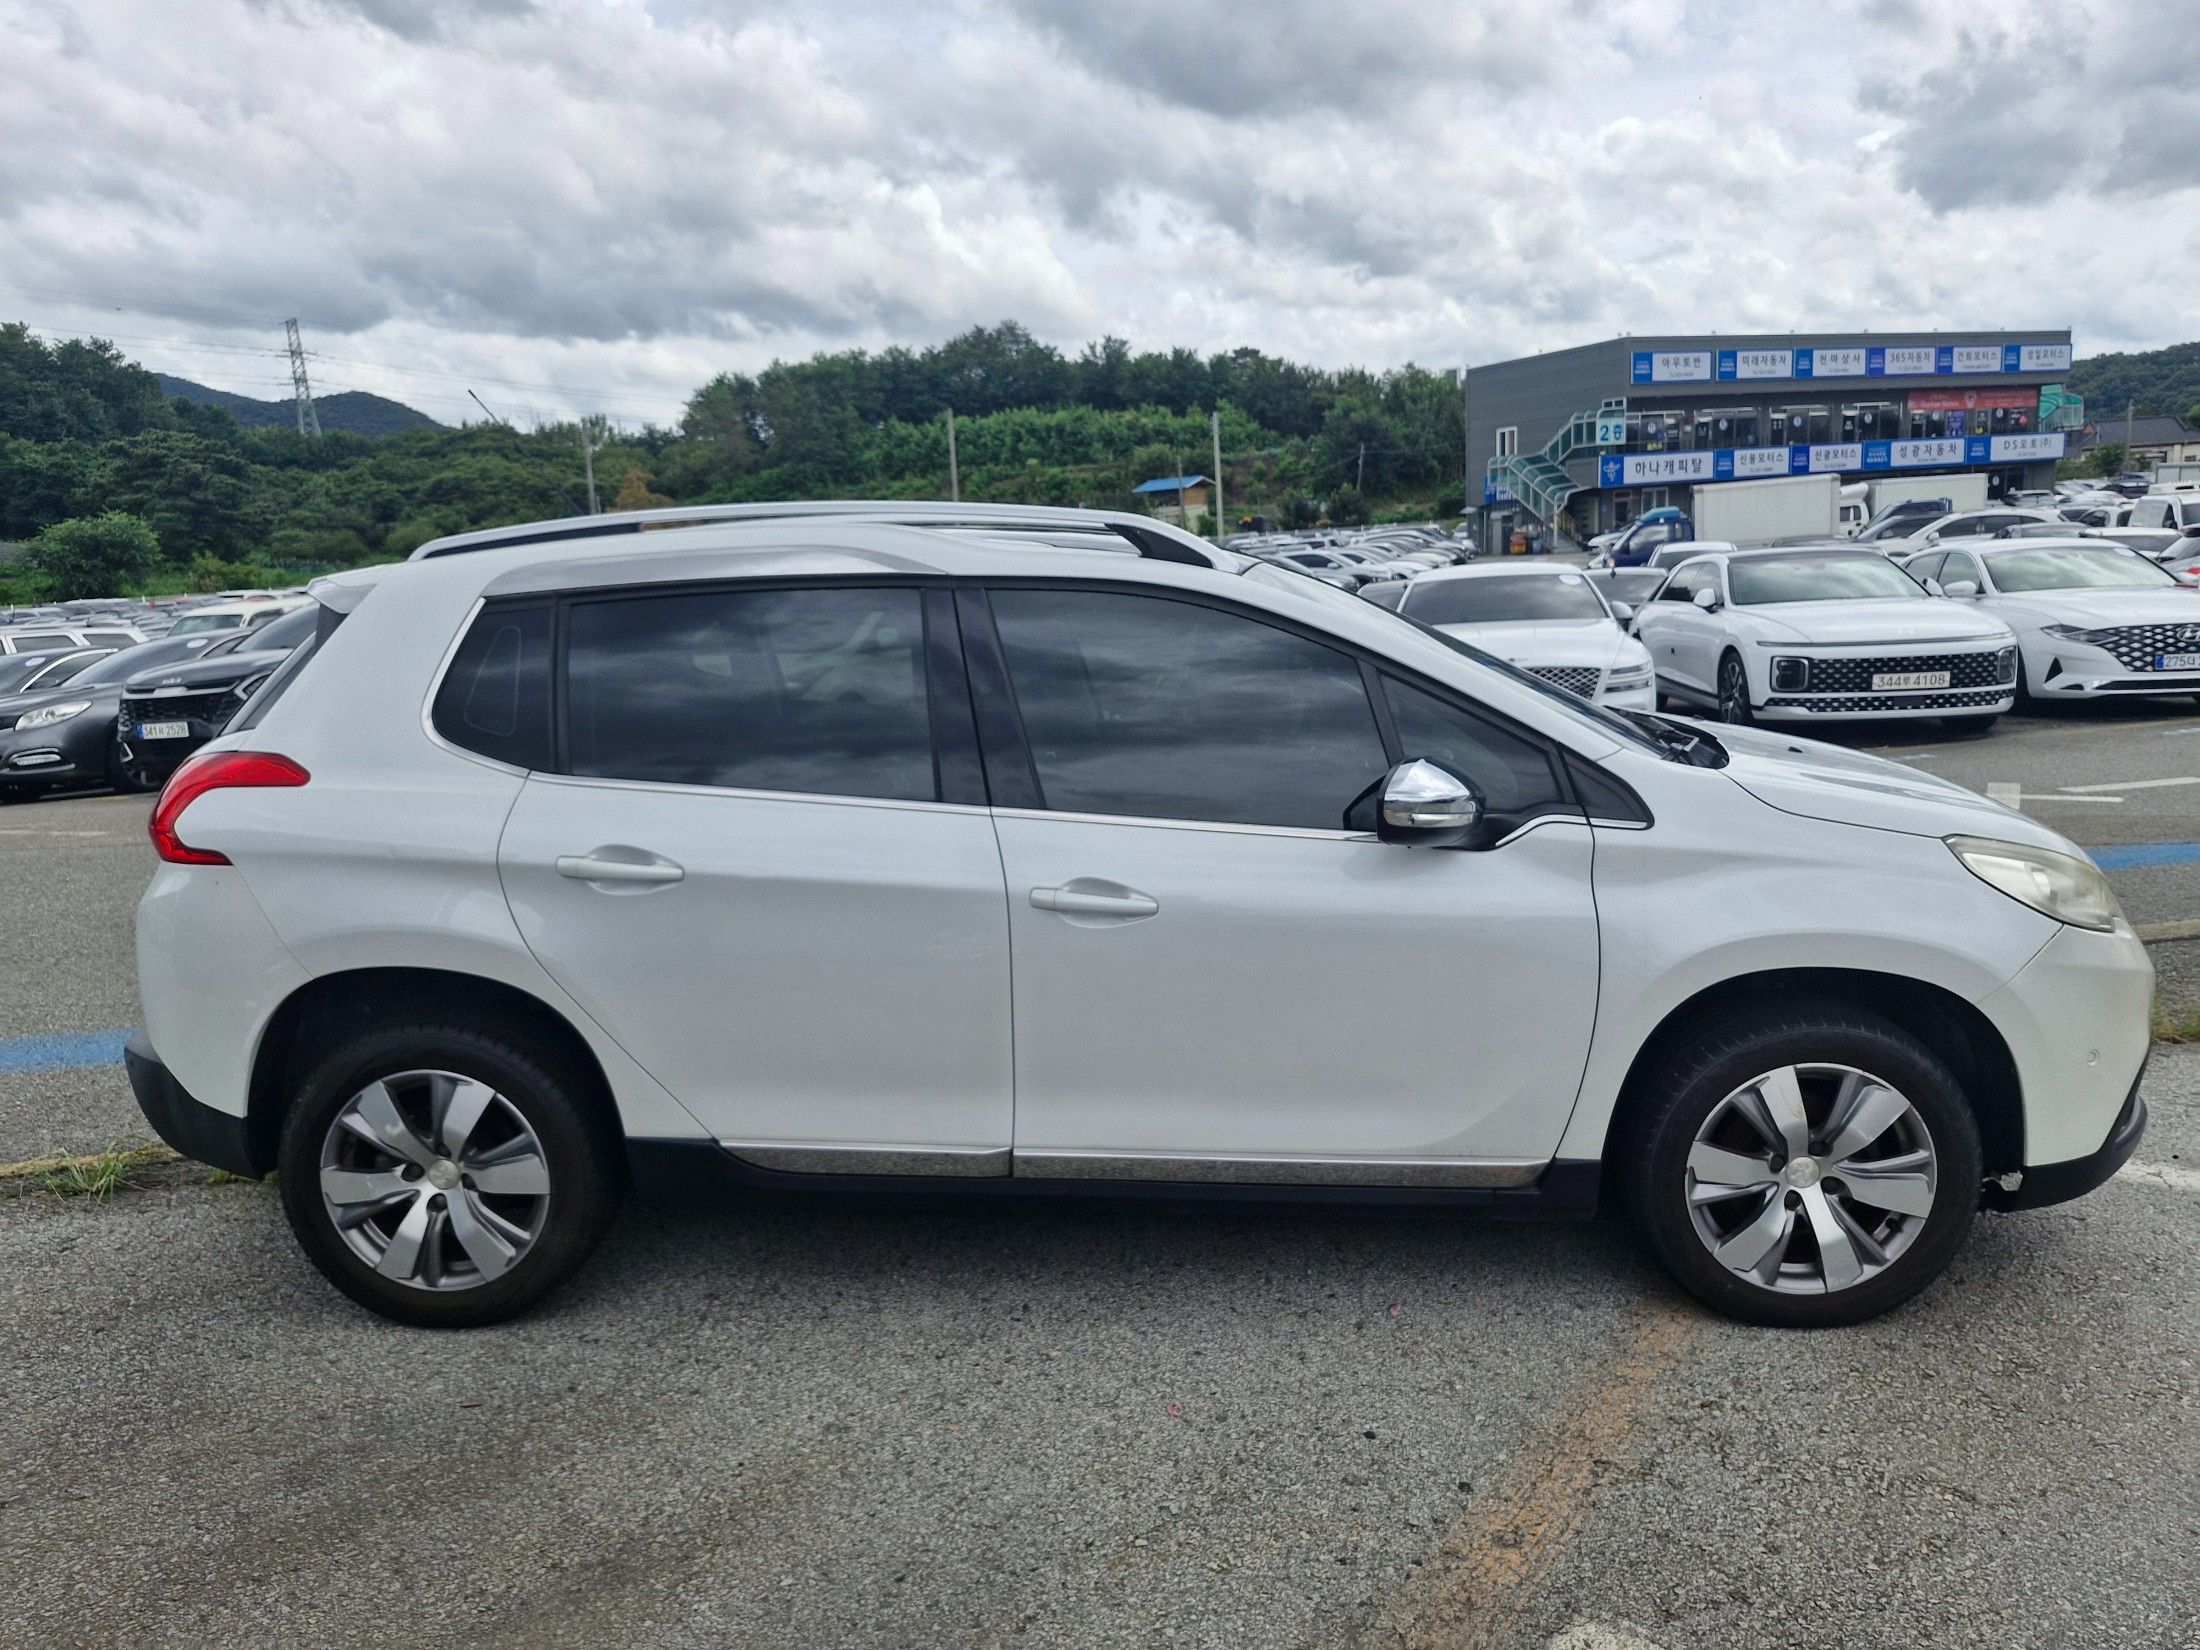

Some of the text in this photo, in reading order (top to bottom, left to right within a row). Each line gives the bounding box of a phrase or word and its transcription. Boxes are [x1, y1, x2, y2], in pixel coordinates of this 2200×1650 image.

[1661, 356, 1701, 369] 아우토반
[1742, 353, 1786, 367] 미래자동차
[1890, 351, 1931, 363] 365자동차
[1634, 458, 1702, 477] 하나캐피탈
